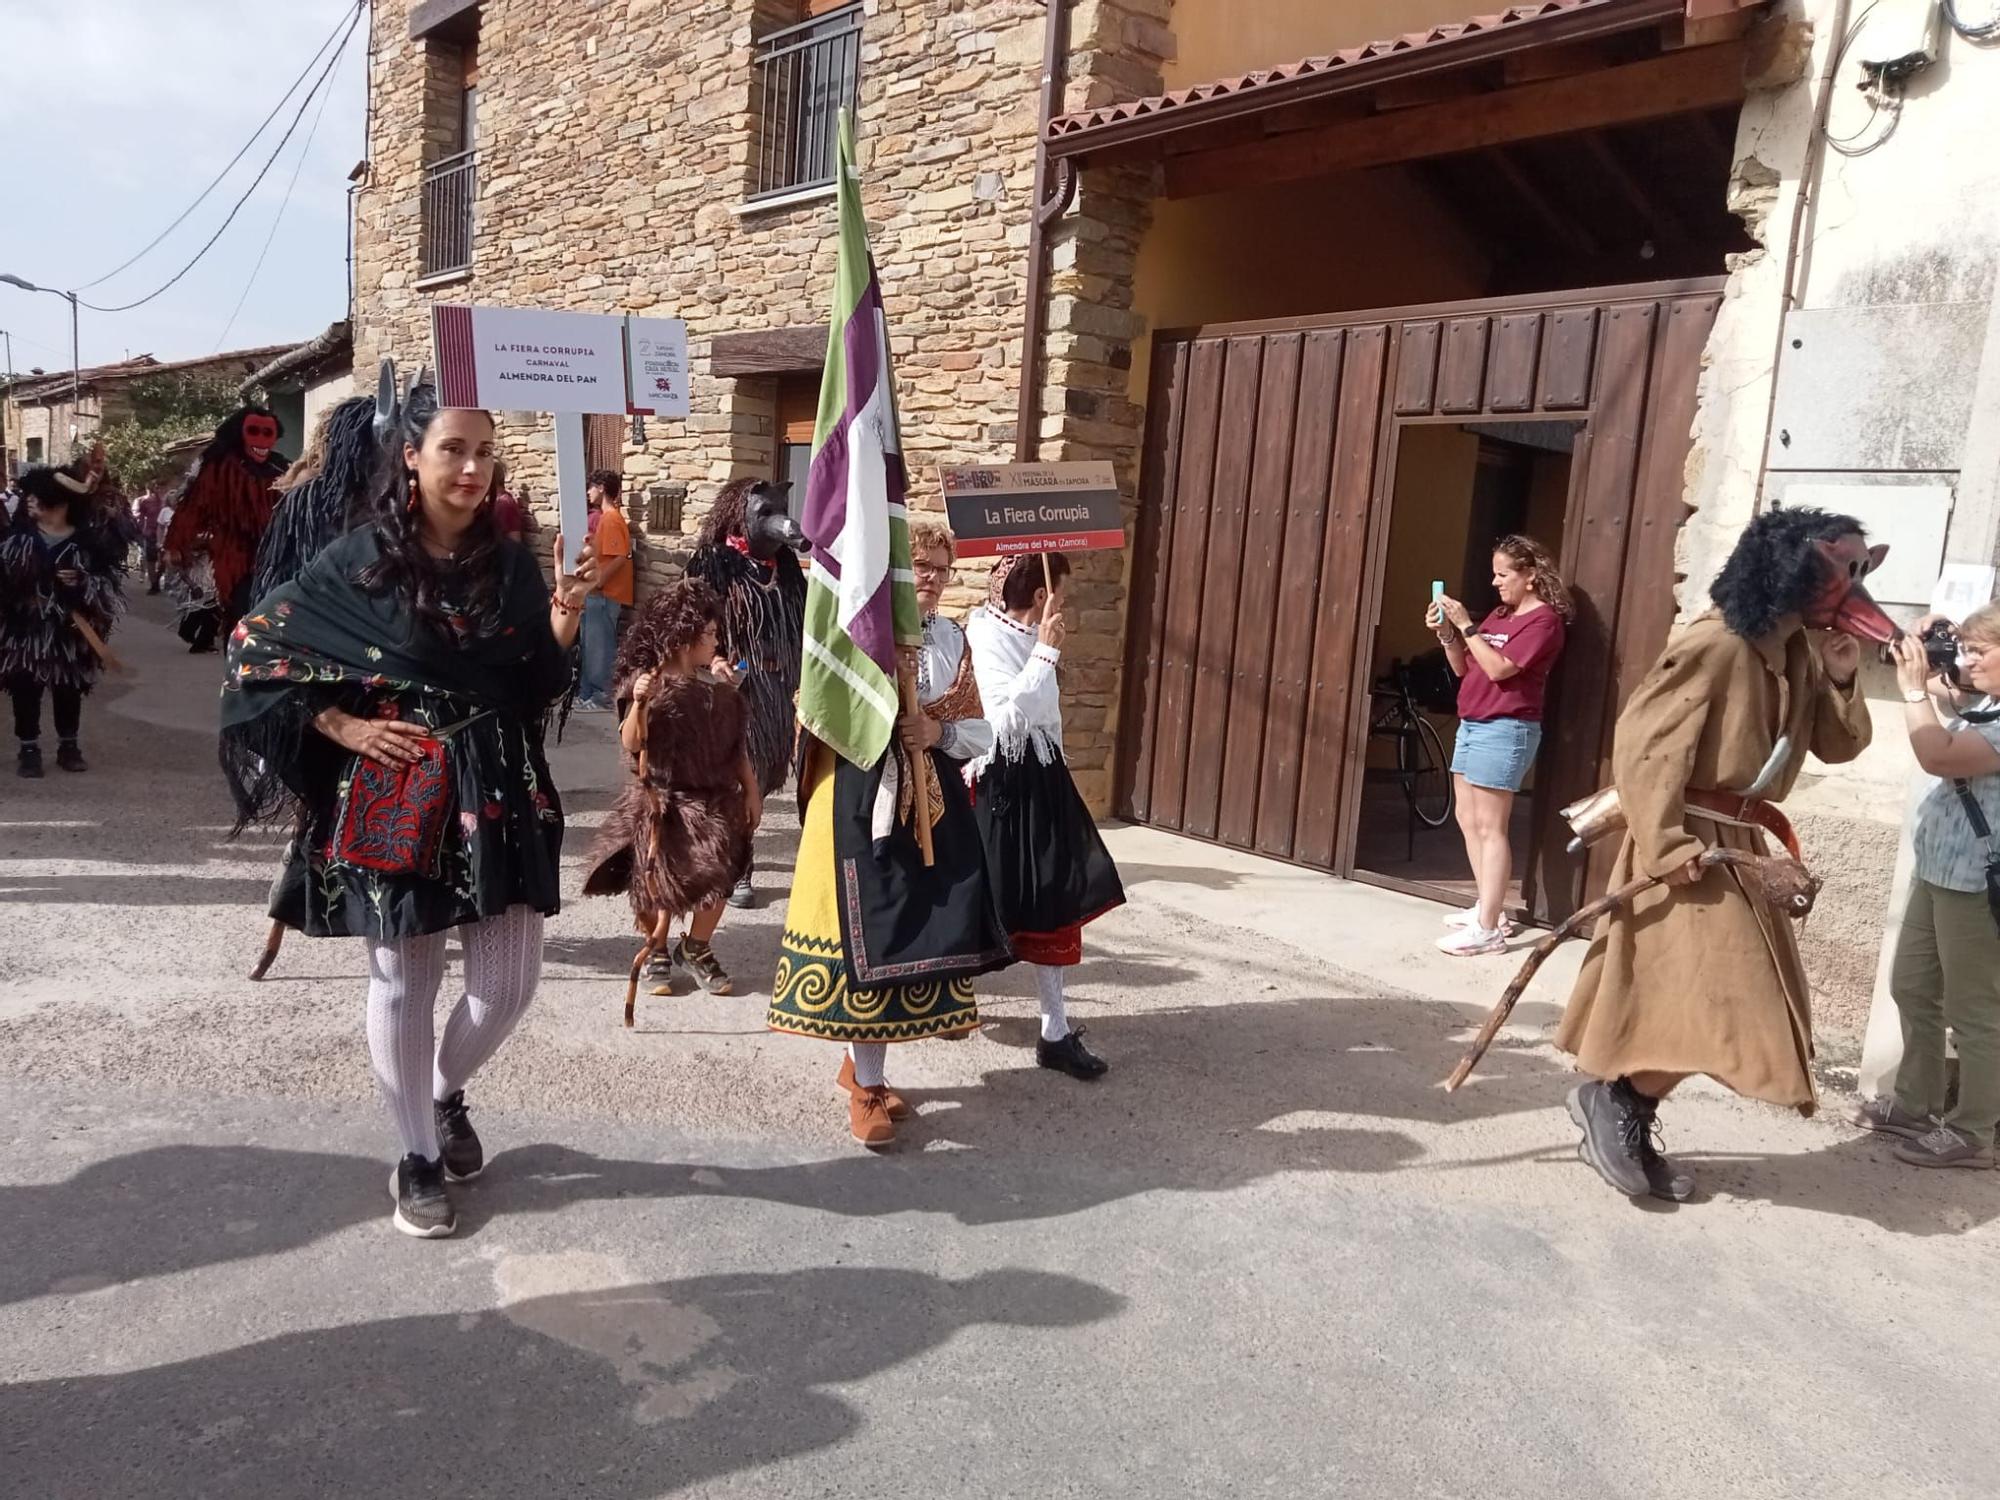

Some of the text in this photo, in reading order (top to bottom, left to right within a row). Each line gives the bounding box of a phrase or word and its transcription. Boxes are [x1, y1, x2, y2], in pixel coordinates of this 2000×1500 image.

[494, 343, 595, 356] LA FIERA CORRUPIA
[525, 359, 570, 368] CARNAVAL
[499, 372, 597, 384] ALMENDRA DEL PAN
[984, 504, 1090, 525] La Fiera Corrupia
[995, 538, 1088, 552] Almendra del Pan (Zamora)
